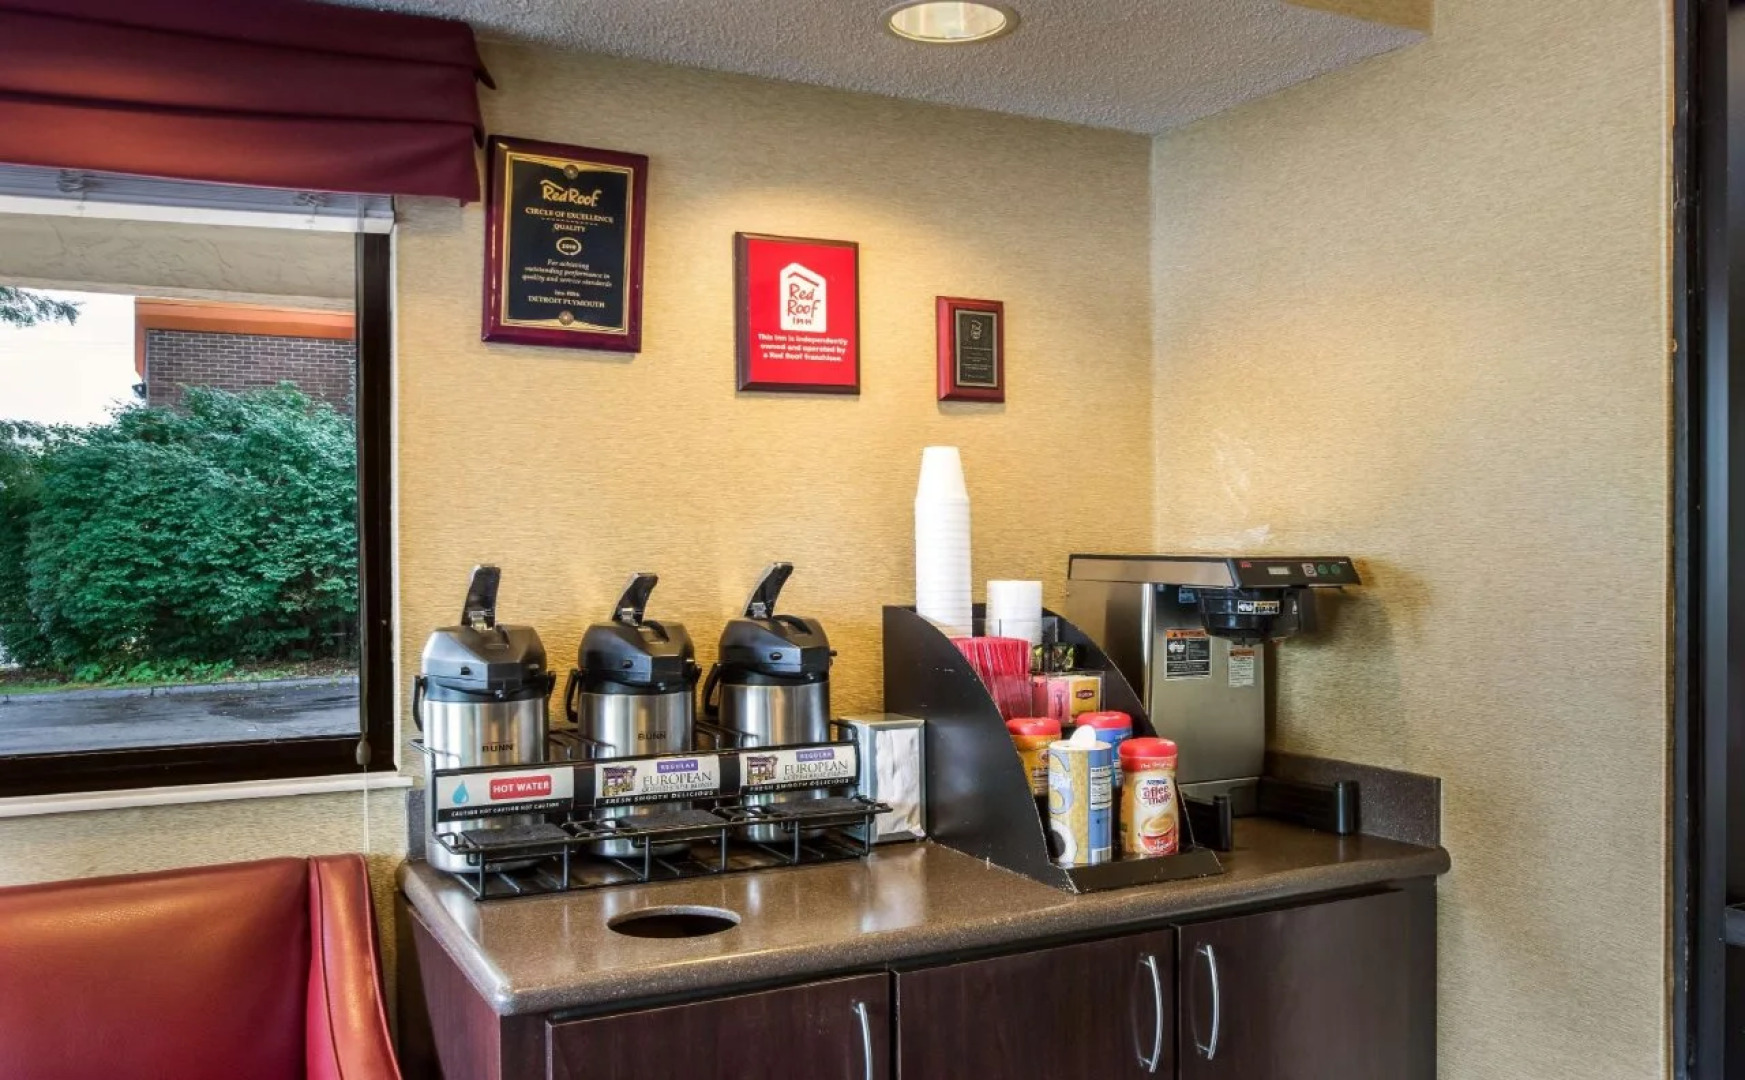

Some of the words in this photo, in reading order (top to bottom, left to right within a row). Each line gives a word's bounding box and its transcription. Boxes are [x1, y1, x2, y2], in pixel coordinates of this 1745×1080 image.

[543, 185, 568, 202] Red
[569, 188, 602, 207] Roof
[525, 207, 554, 216] CIRCLE
[566, 211, 614, 223] EXCELLENCE
[554, 224, 586, 232] QUALITY
[559, 261, 590, 271] achieving
[564, 269, 602, 279] performance
[789, 283, 815, 300] Red
[528, 295, 561, 305] DETROIT
[563, 299, 605, 308] PLYMOUTH
[787, 299, 821, 318] Roof
[795, 335, 848, 346] independently
[802, 345, 835, 354] operated
[785, 352, 802, 360] Roof
[638, 731, 667, 741] BUNN
[482, 743, 513, 752] BUNN
[800, 751, 833, 759] REGULAR
[784, 760, 849, 775] EUROPEAN
[643, 771, 712, 786] EUROPEAN
[493, 784, 514, 793] HOT
[516, 781, 549, 792] WATER
[635, 793, 669, 802] SMOOTH
[671, 790, 714, 799] DELICIOUS
[451, 808, 478, 817] CAUTION
[493, 805, 519, 813] CAUTION
[534, 802, 560, 810] CAUTION
